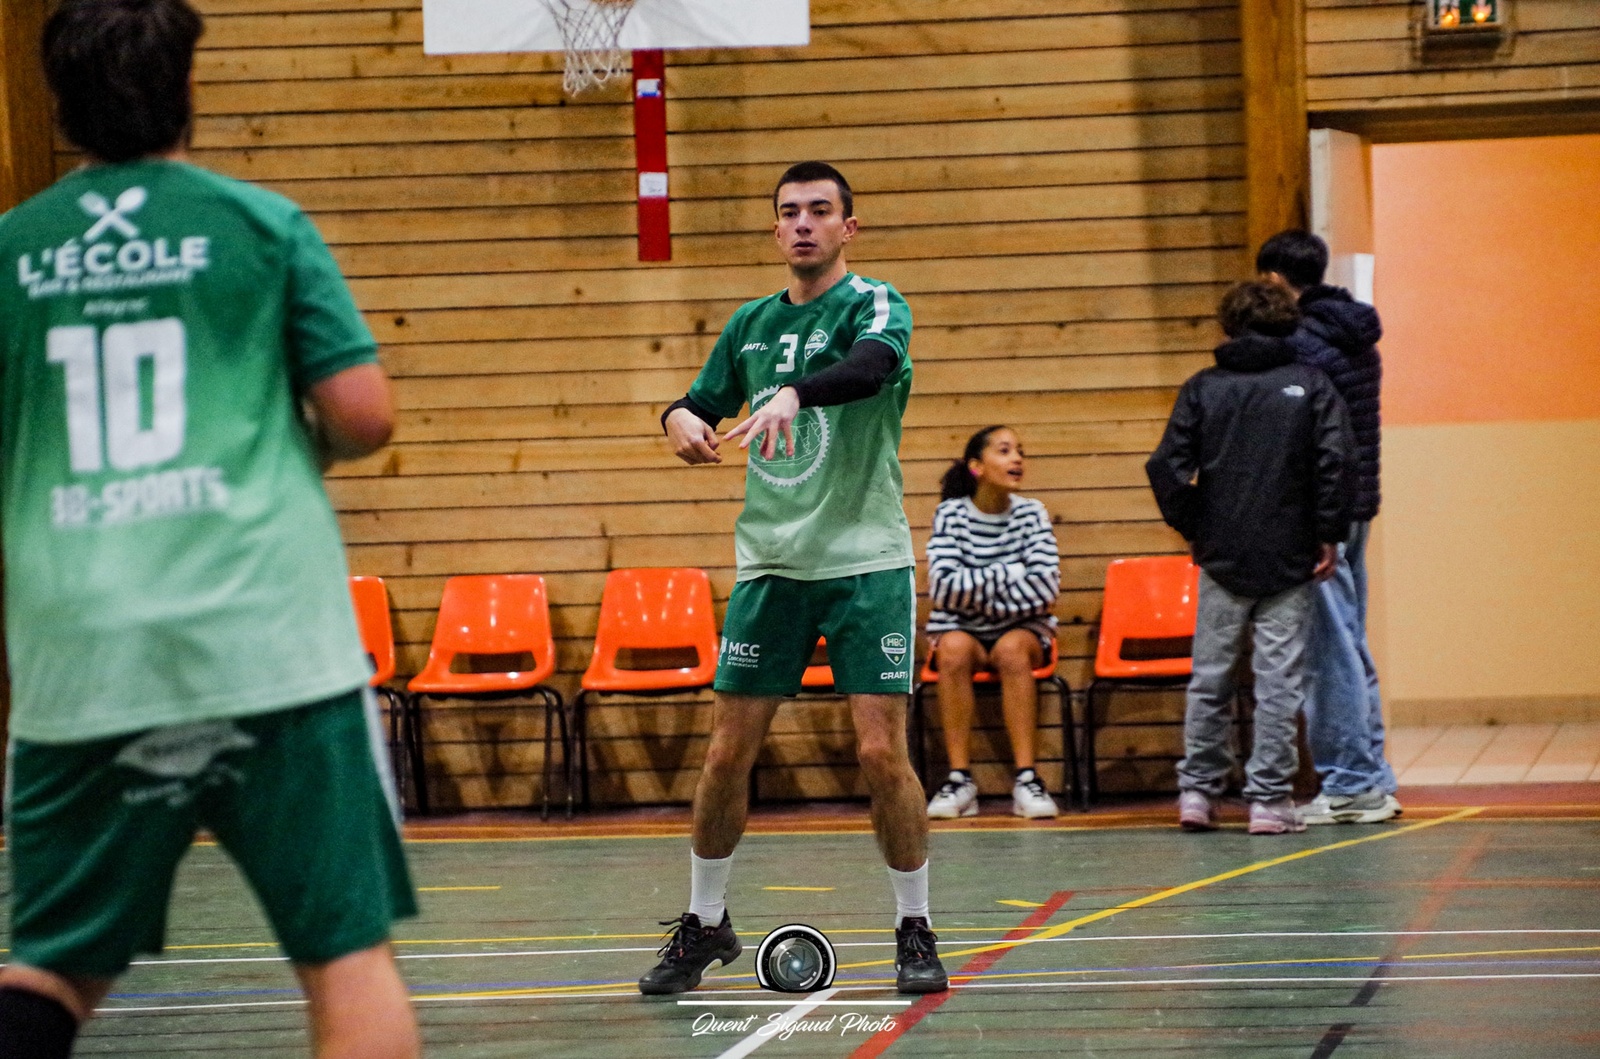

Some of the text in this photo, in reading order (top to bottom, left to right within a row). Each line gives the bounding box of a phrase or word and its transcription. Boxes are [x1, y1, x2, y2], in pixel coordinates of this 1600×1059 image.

[17, 236, 210, 287] L'ÉCOLE
[776, 334, 798, 373] 3
[46, 317, 187, 473] 10
[729, 642, 761, 657] MCC
[886, 637, 904, 647] HBC
[727, 655, 759, 664] Concepteur
